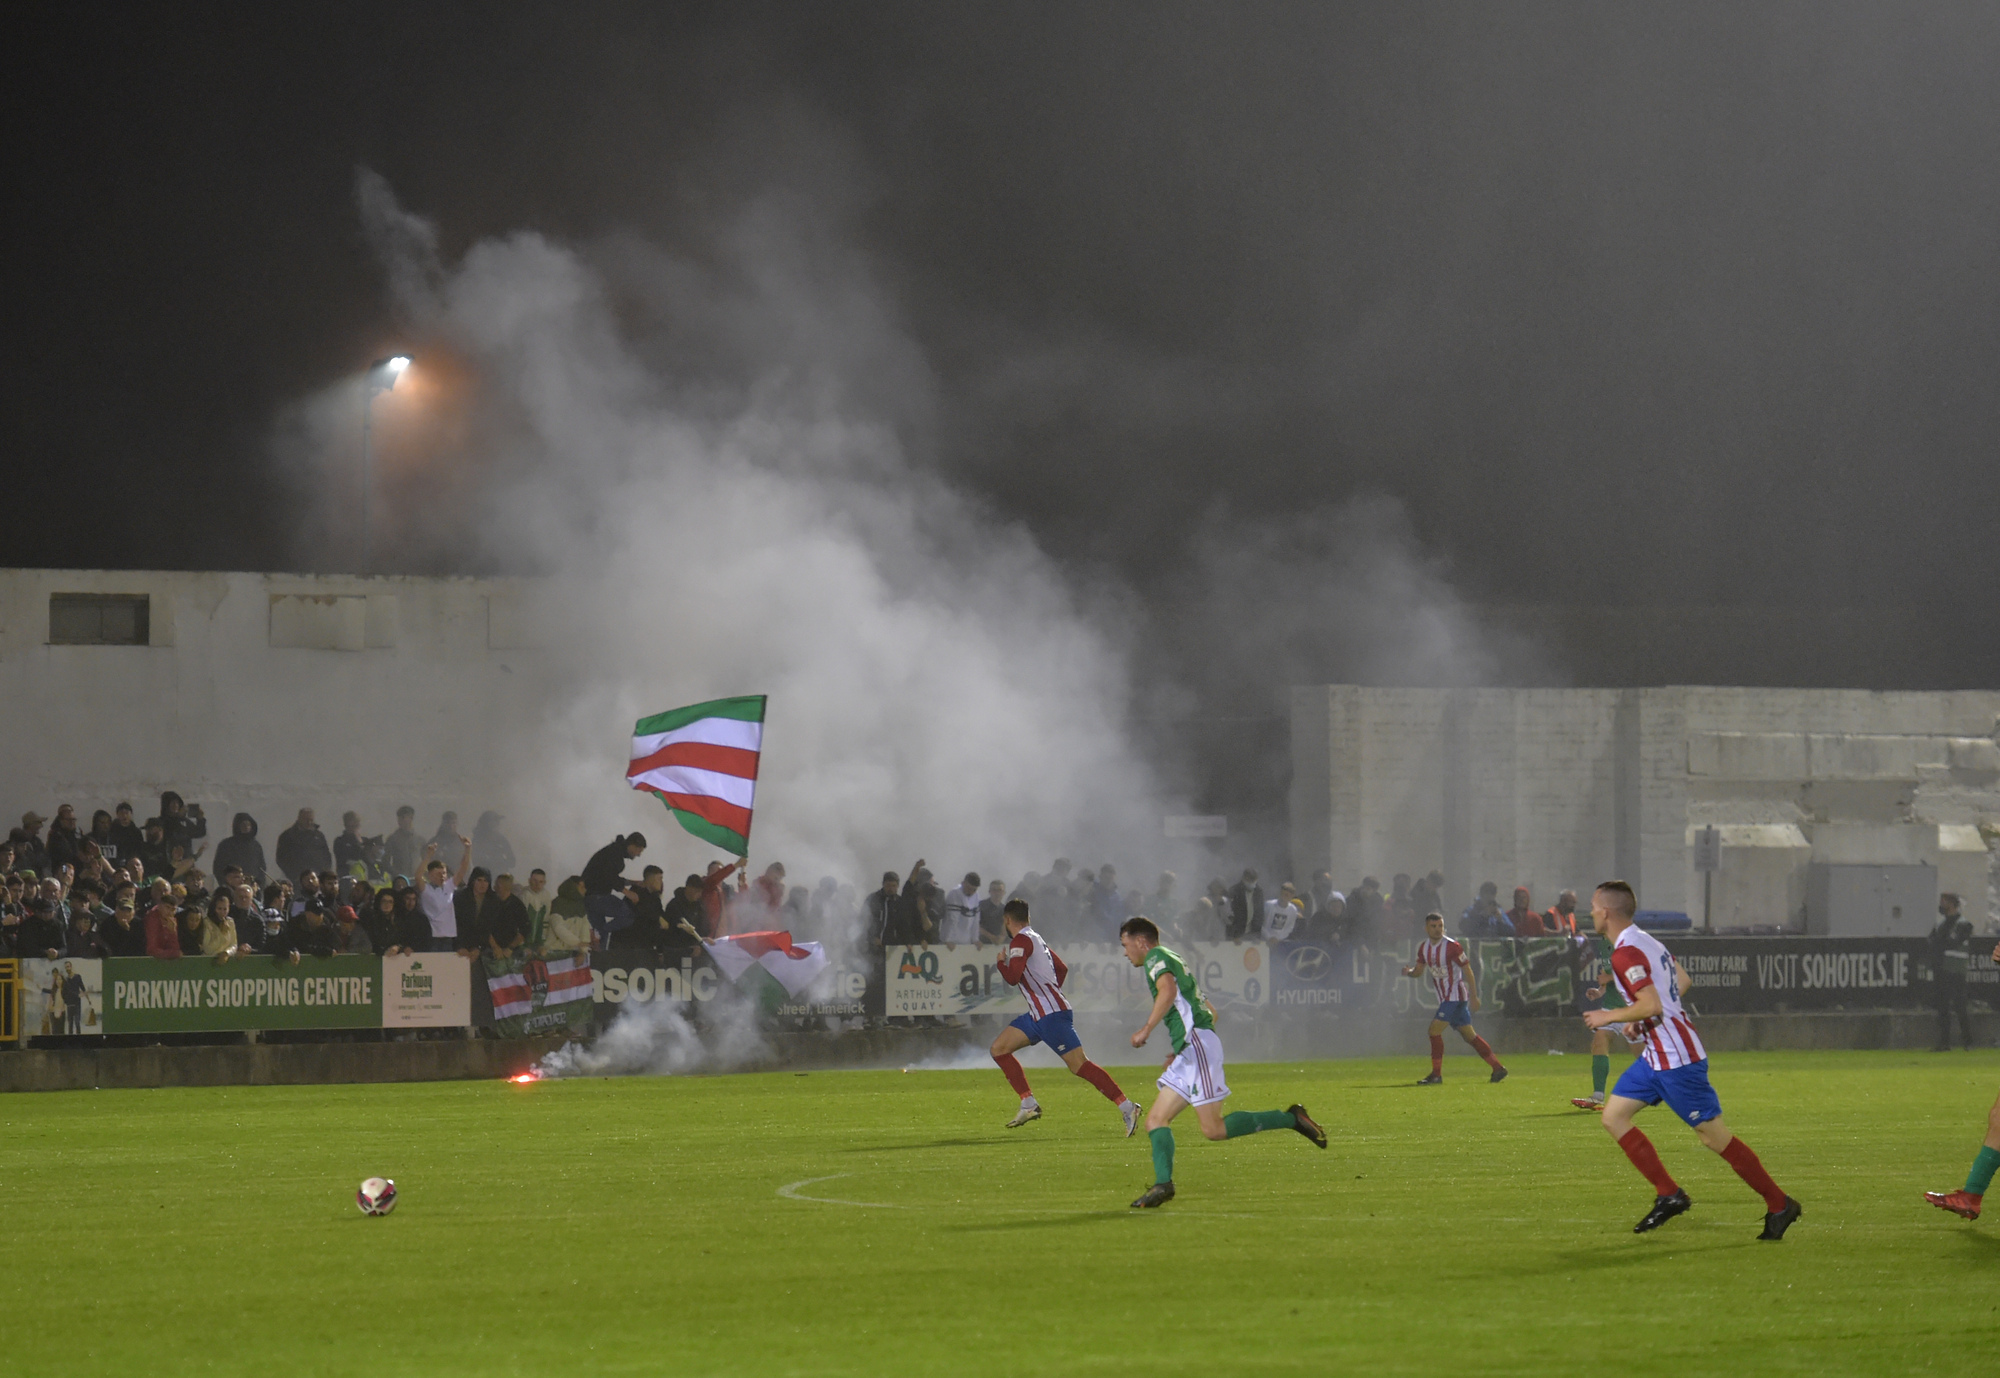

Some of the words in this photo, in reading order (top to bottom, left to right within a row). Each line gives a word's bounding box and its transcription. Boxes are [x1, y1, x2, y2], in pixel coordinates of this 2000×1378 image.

[897, 951, 943, 985] AQ
[1676, 955, 1720, 972] TLETROY
[1722, 955, 1748, 972] PARK
[1757, 953, 1798, 989] VISIT
[1802, 953, 1909, 988] SOHOTELS.IE
[401, 973, 433, 990] Parkway
[590, 957, 718, 1003] asonic
[1691, 973, 1721, 987] LEISURE
[1722, 973, 1742, 987] CLUB
[114, 979, 203, 1010] PARKWAY
[206, 978, 299, 1008] SHOPPING
[303, 977, 372, 1006] CENTRE
[1276, 988, 1342, 1005] HYUNDAI
[817, 1002, 866, 1015] Limerick
[902, 1002, 935, 1012] QUAY
